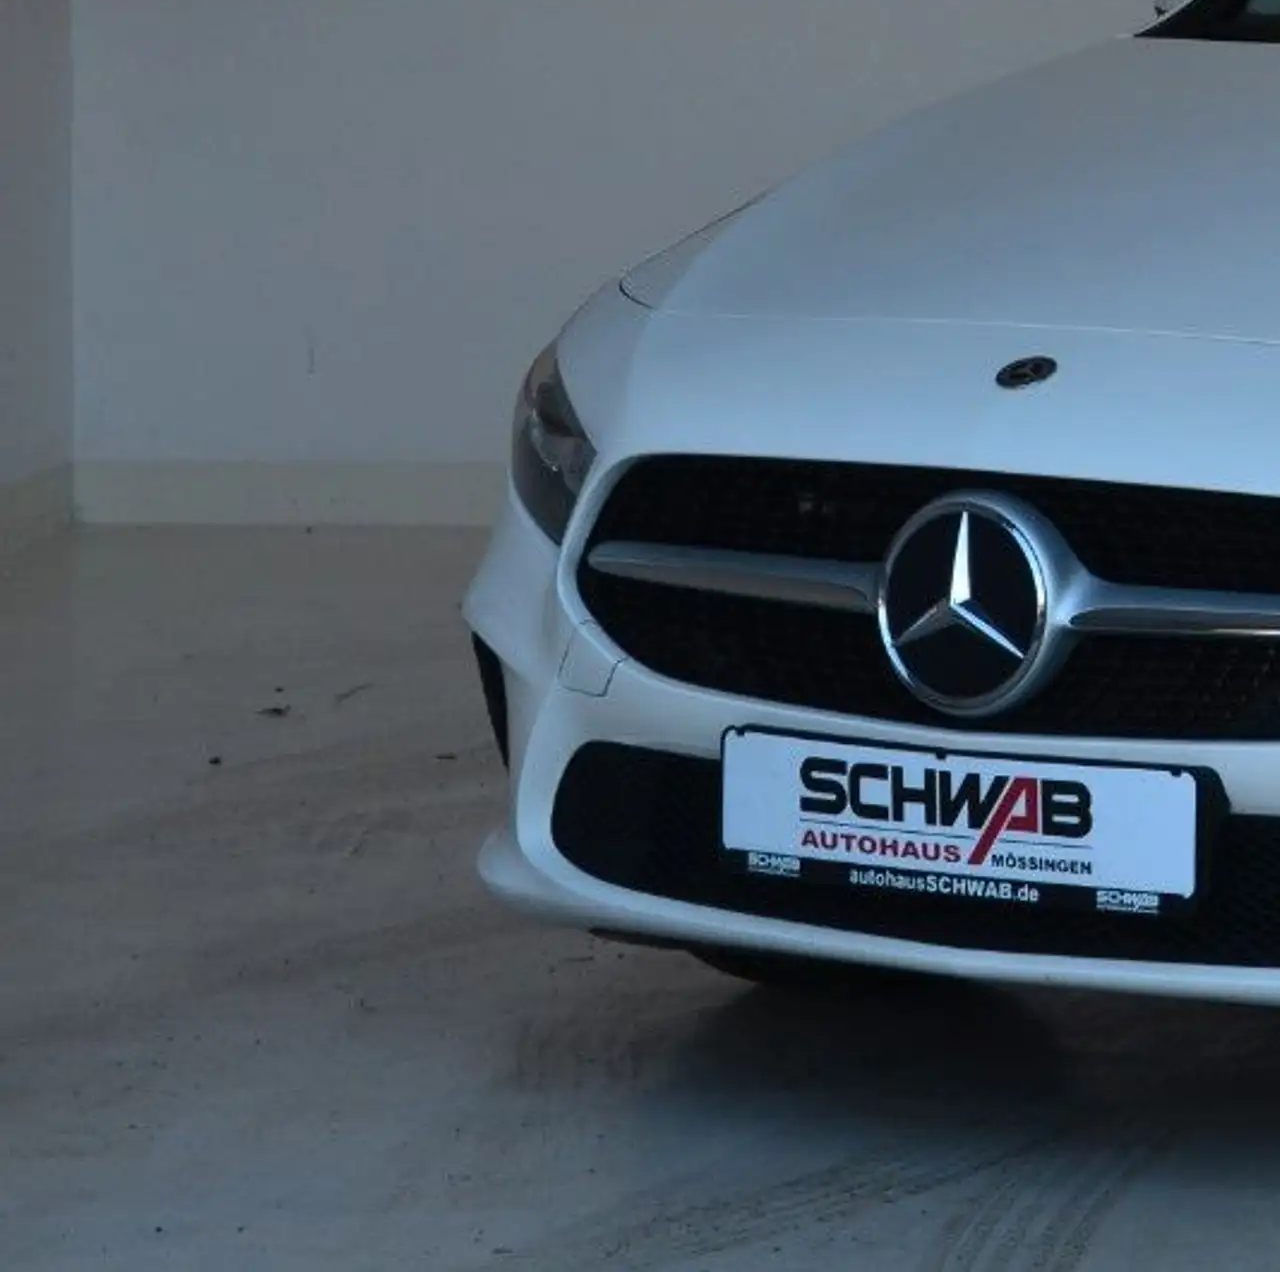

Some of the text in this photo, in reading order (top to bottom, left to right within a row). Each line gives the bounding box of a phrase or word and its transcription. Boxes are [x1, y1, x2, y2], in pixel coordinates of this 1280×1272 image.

[800, 756, 1092, 865] SCHWAB
[801, 828, 962, 864] AUTOHAUS
[991, 853, 1093, 876] MÖSSINGEN
[849, 868, 1040, 902] autohausSCHWAB.de
